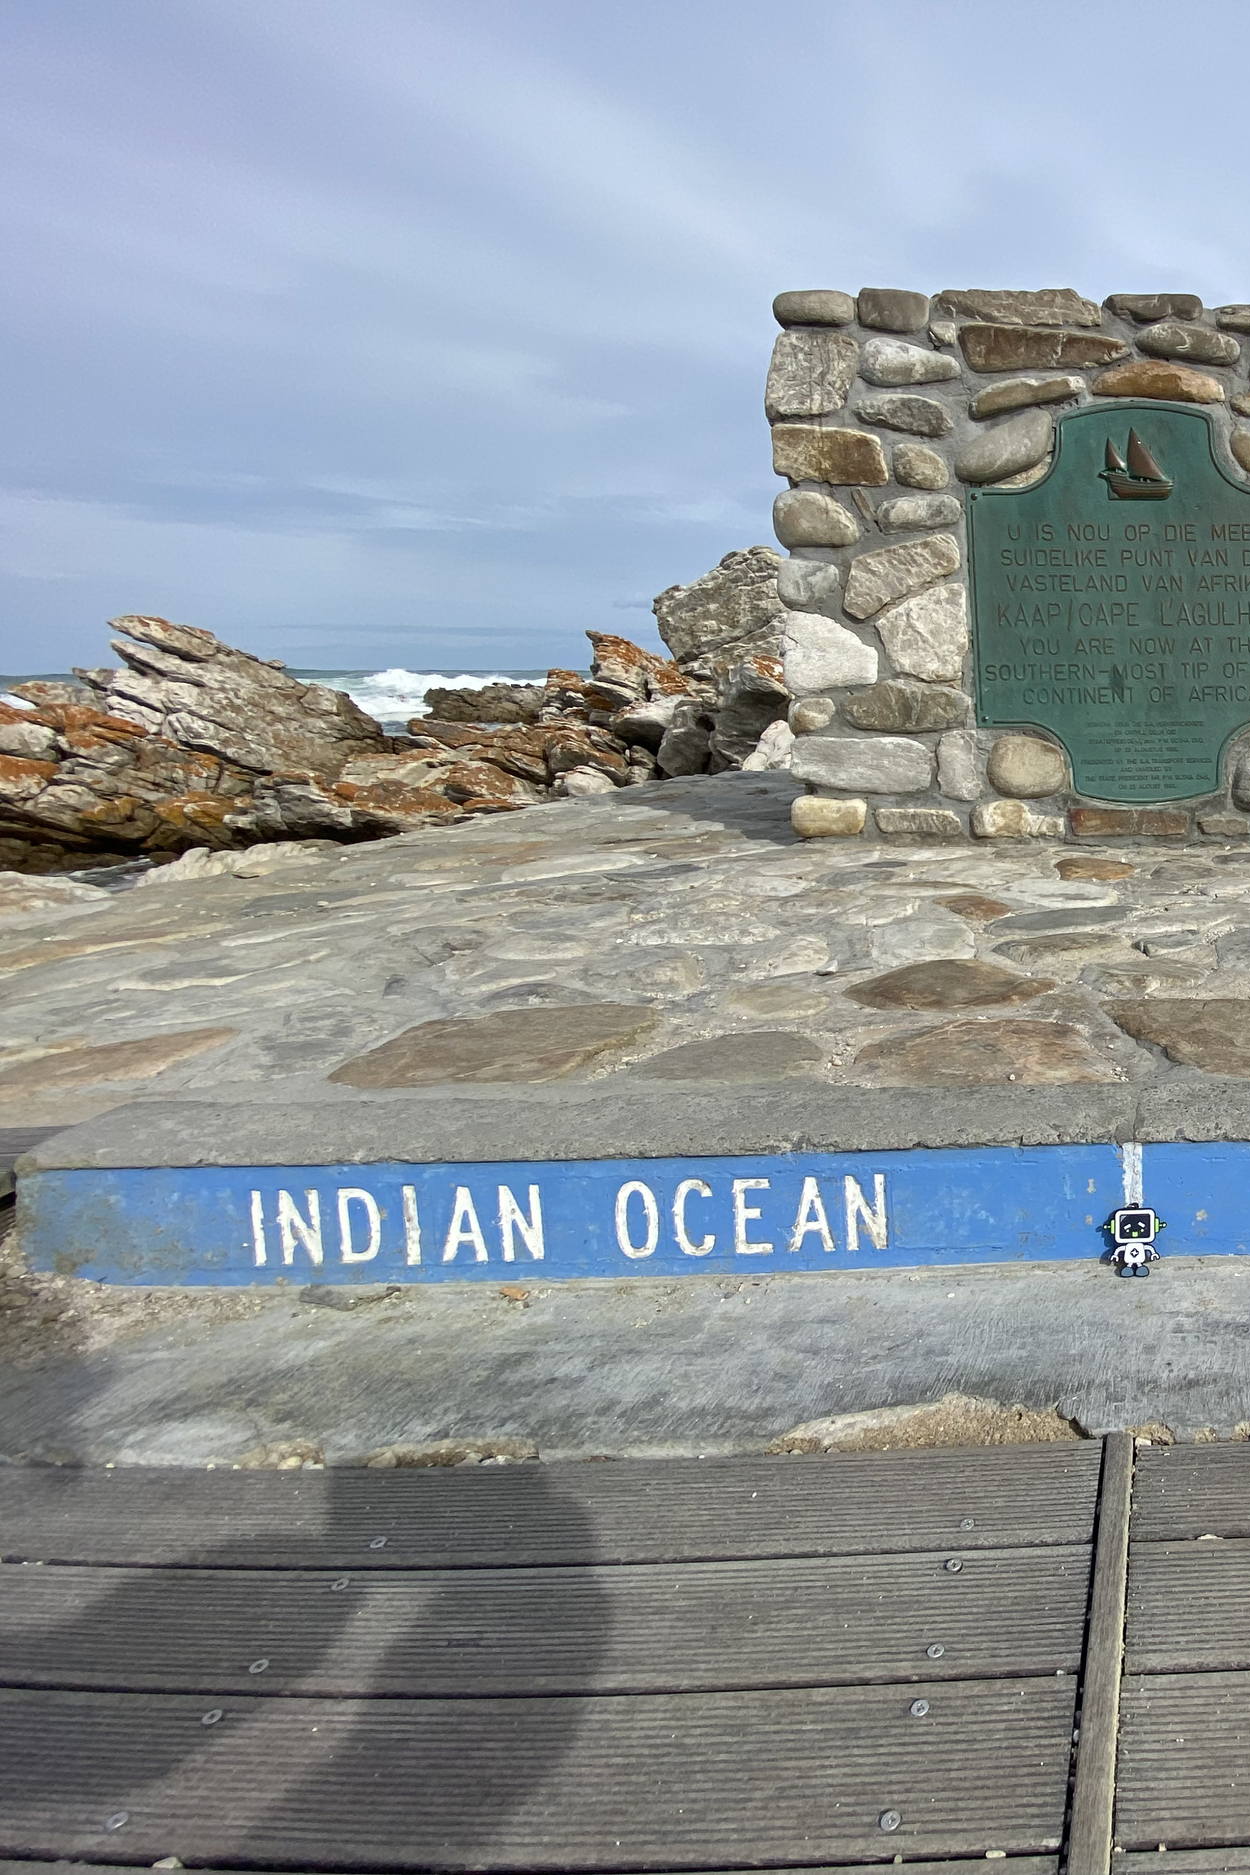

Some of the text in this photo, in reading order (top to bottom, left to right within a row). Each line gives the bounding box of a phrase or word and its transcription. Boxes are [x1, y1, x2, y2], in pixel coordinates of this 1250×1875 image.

[1007, 523, 1021, 541] U
[1035, 524, 1054, 541] IS
[1068, 524, 1110, 541] NOU
[1124, 524, 1151, 541] OP
[1164, 524, 1197, 541] DIE
[1000, 549, 1107, 567] SUIDELIKE
[1121, 549, 1173, 567] PUNT
[1188, 549, 1228, 567] VAN
[1006, 574, 1128, 592] VASTELAND
[1141, 574, 1183, 592] VAN
[998, 599, 1139, 632] KAAP/CAPE
[1018, 638, 1060, 656] YOU
[1074, 637, 1114, 655] ARE
[1130, 637, 1175, 655] NOW
[1189, 637, 1213, 654] AT
[985, 662, 1166, 682] SOUTHERN-MOST
[1181, 662, 1209, 680] TIP
[1222, 662, 1247, 679] OF
[1022, 686, 1134, 705] CONTINENT
[1150, 686, 1174, 704] OF
[250, 1173, 889, 1266] INDIAN OCEAN
